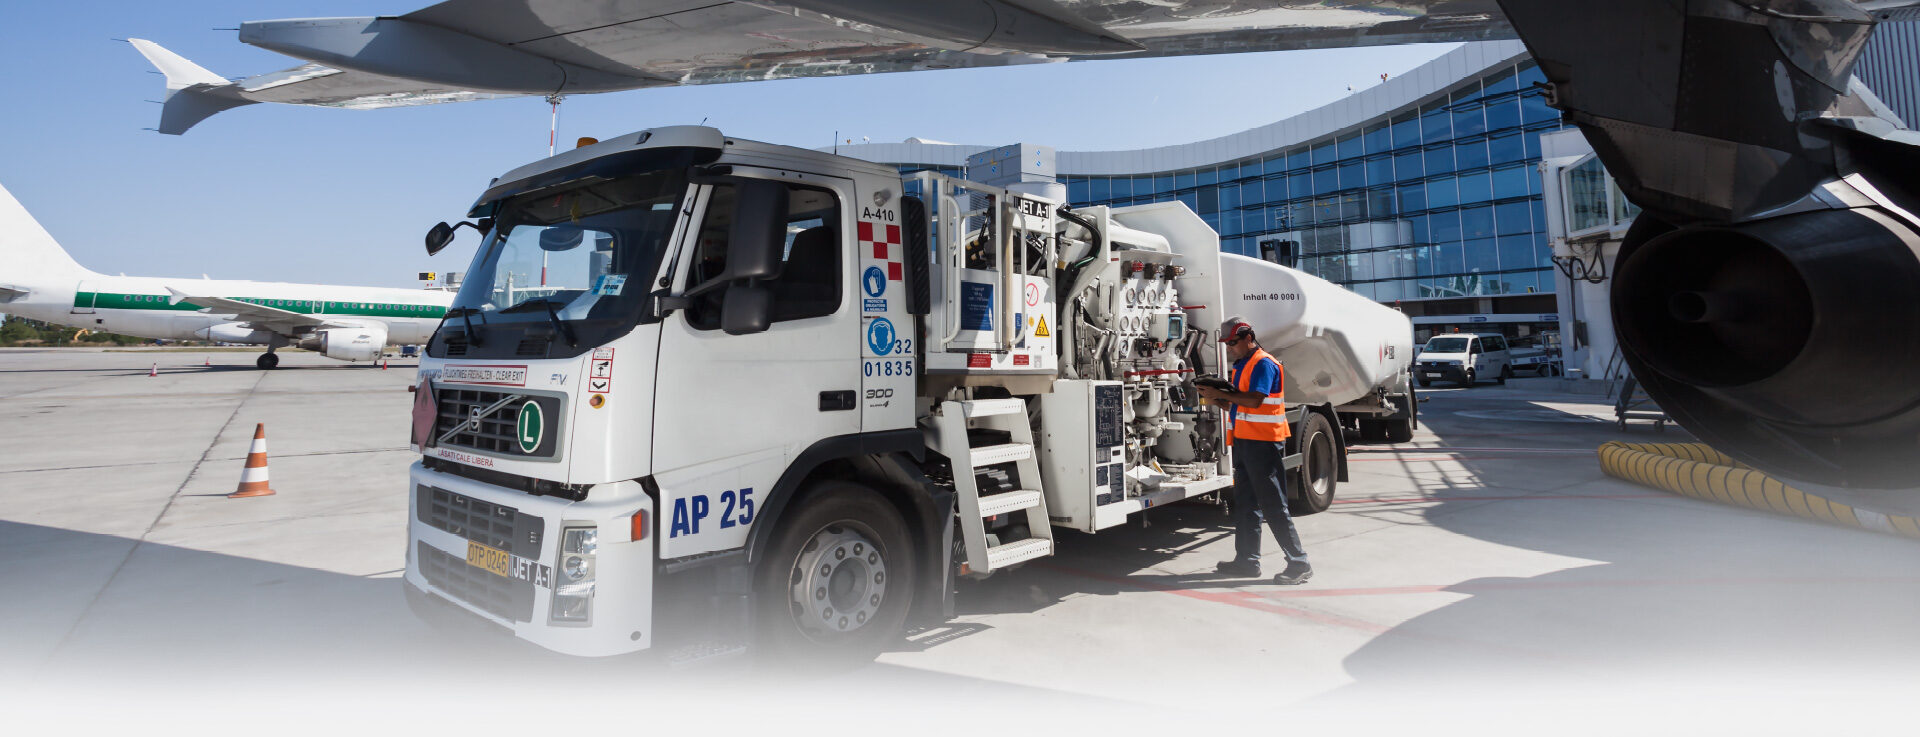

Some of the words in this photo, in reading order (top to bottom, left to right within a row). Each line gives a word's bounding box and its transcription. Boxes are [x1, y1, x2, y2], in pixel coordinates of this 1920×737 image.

[863, 207, 894, 222] A-410
[1018, 199, 1034, 214] JET
[1036, 202, 1050, 218] A-1
[1243, 293, 1266, 301] Inhalt
[1269, 293, 1279, 301] 40
[895, 339, 912, 354] 32
[496, 371, 511, 381] CLEAR
[512, 371, 524, 381] EXIT
[864, 361, 913, 377] 01835
[866, 388, 894, 399] 300
[523, 410, 534, 443] L
[456, 453, 470, 463] CALE
[669, 494, 709, 539] AP
[720, 487, 754, 529] 25
[468, 543, 485, 565] OTP
[486, 549, 507, 574] 0246
[513, 555, 532, 582] JET
[534, 563, 552, 589] A-1
